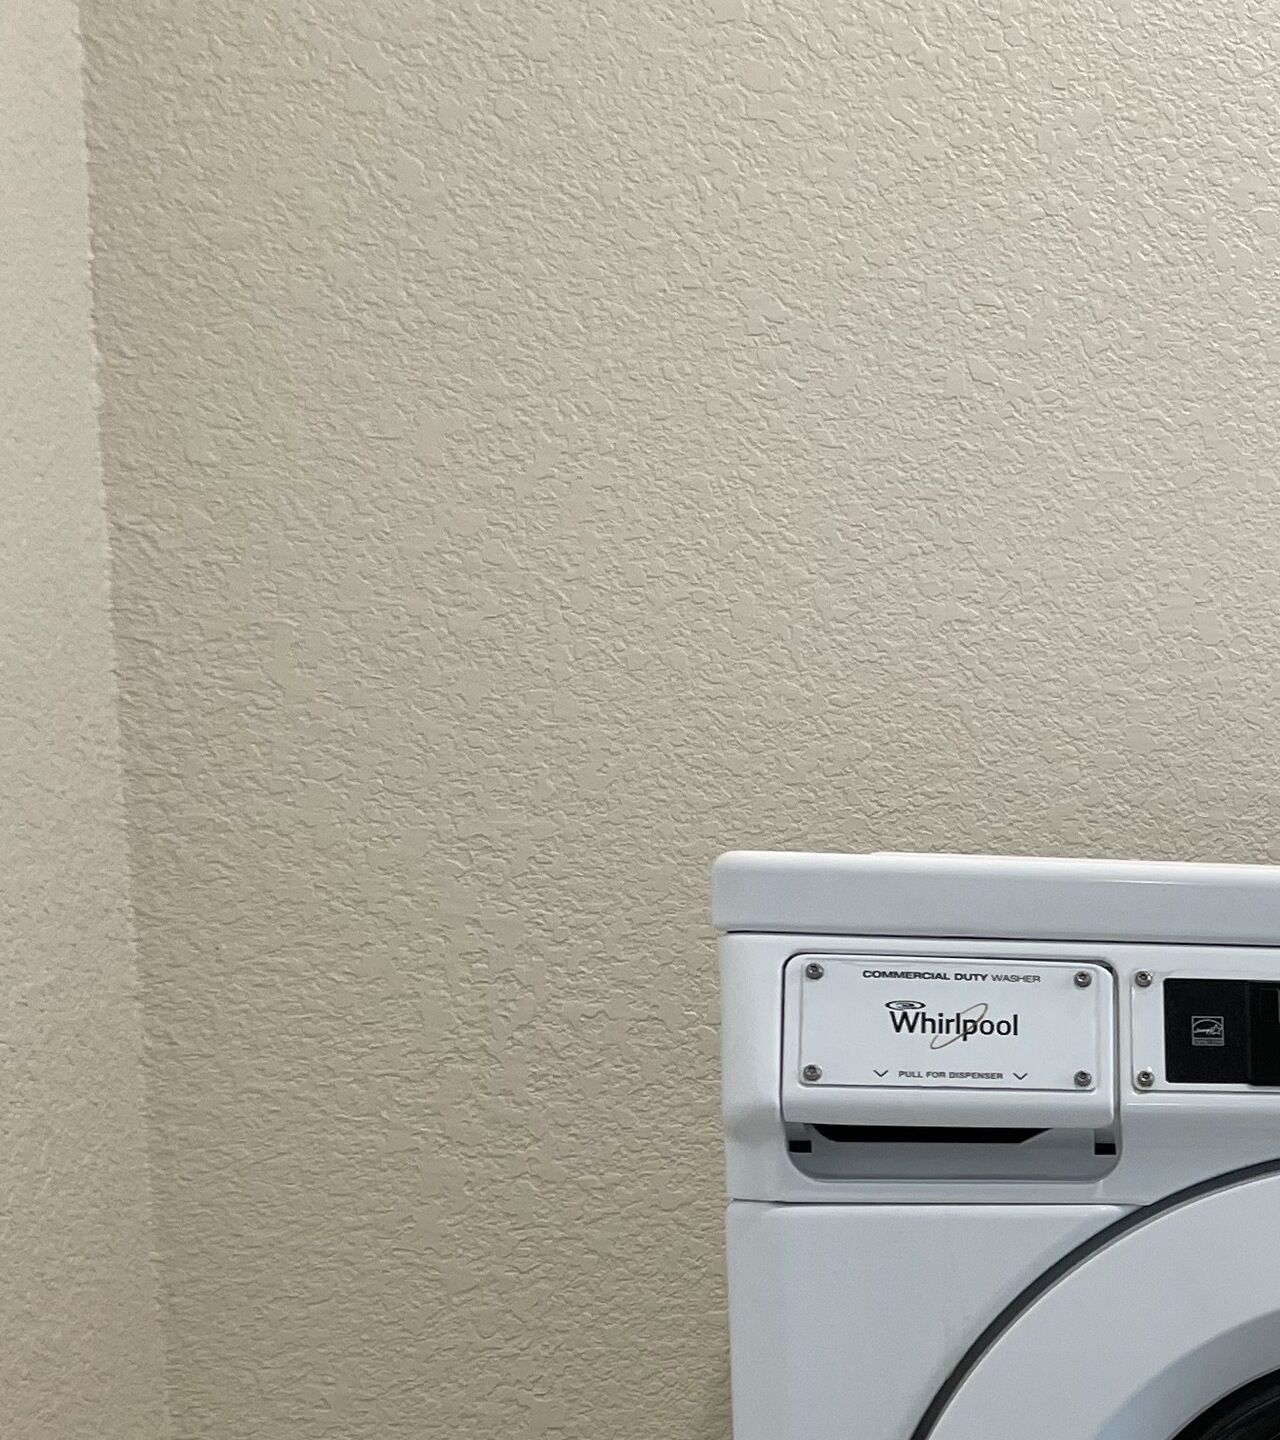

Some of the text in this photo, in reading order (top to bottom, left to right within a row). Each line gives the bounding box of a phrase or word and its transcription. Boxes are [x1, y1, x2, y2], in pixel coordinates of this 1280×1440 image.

[862, 970, 1041, 983] COMMERCIAL DUTY WASHER
[889, 1010, 1019, 1041] Whirlpool
[898, 1070, 1004, 1080] PULL FOR DISPENSER
